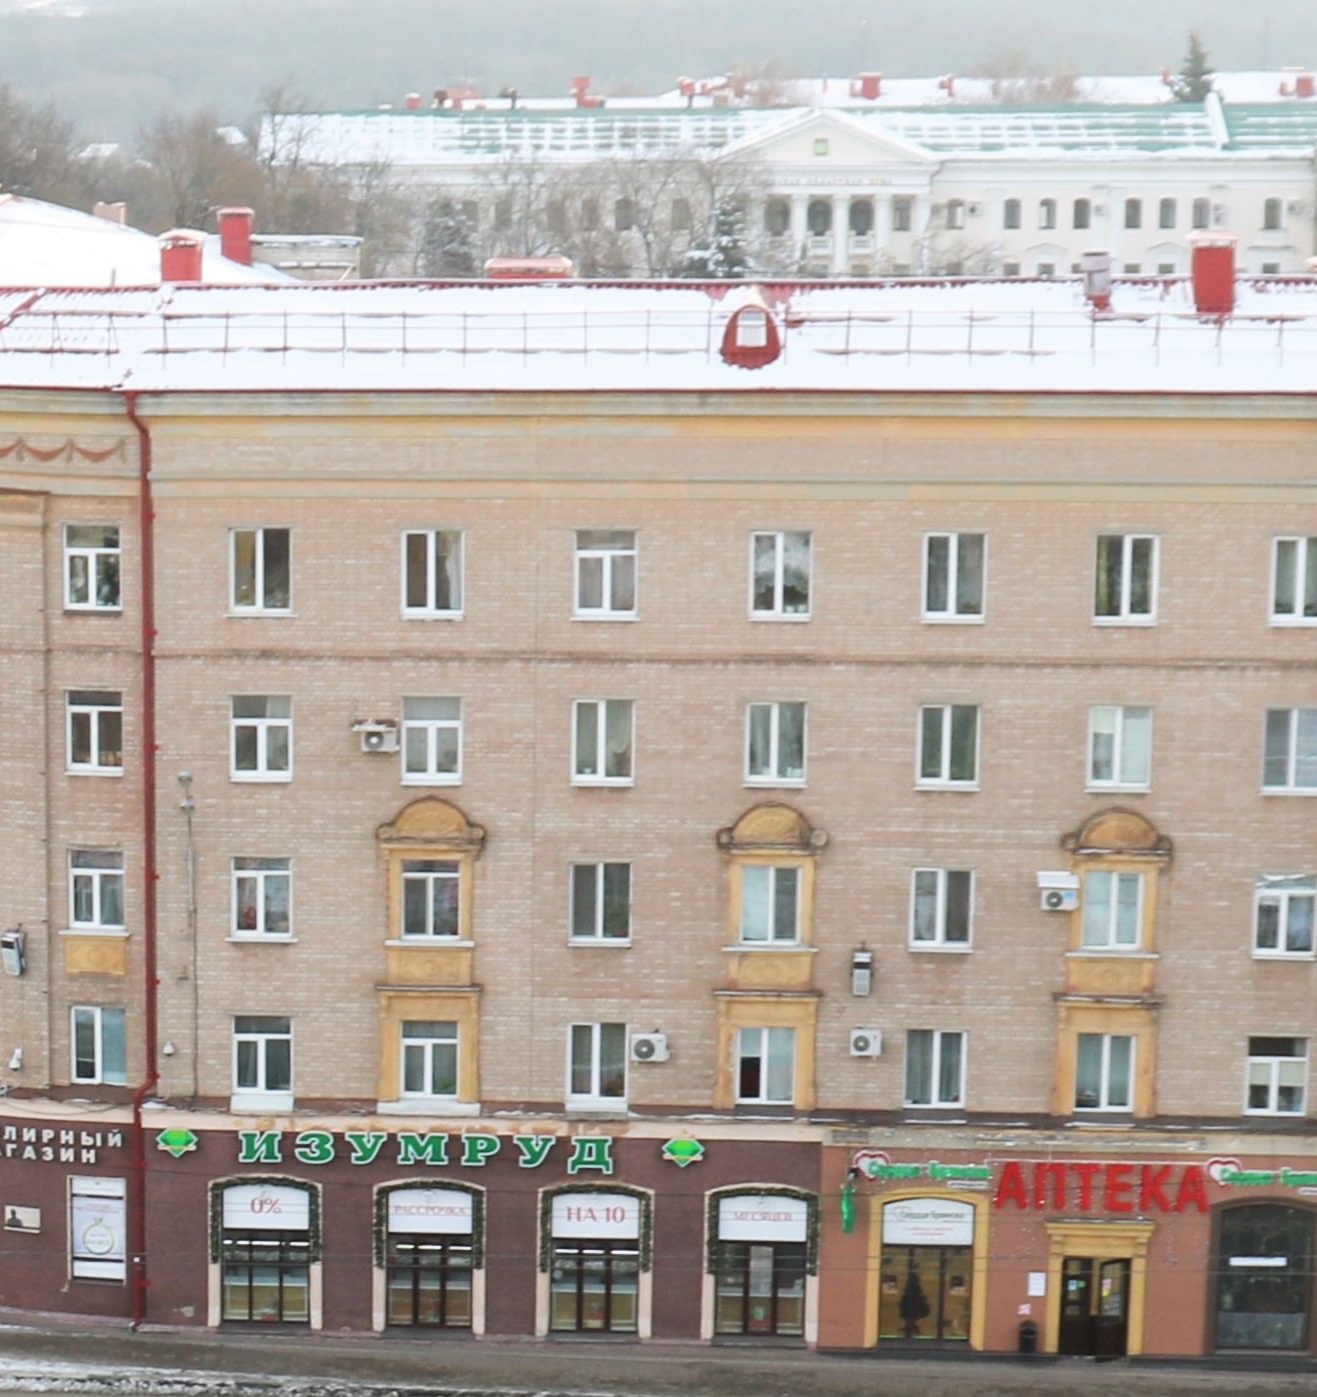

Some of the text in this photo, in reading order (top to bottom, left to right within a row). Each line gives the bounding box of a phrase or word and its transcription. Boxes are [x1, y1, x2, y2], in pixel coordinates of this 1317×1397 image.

[238, 1130, 614, 1174] ИЗУМРУД
[994, 1161, 1210, 1213] АПТЕКА
[250, 1195, 283, 1215] 0%
[394, 1204, 467, 1217] РАССРОЧКА
[567, 1206, 627, 1224] НА 10
